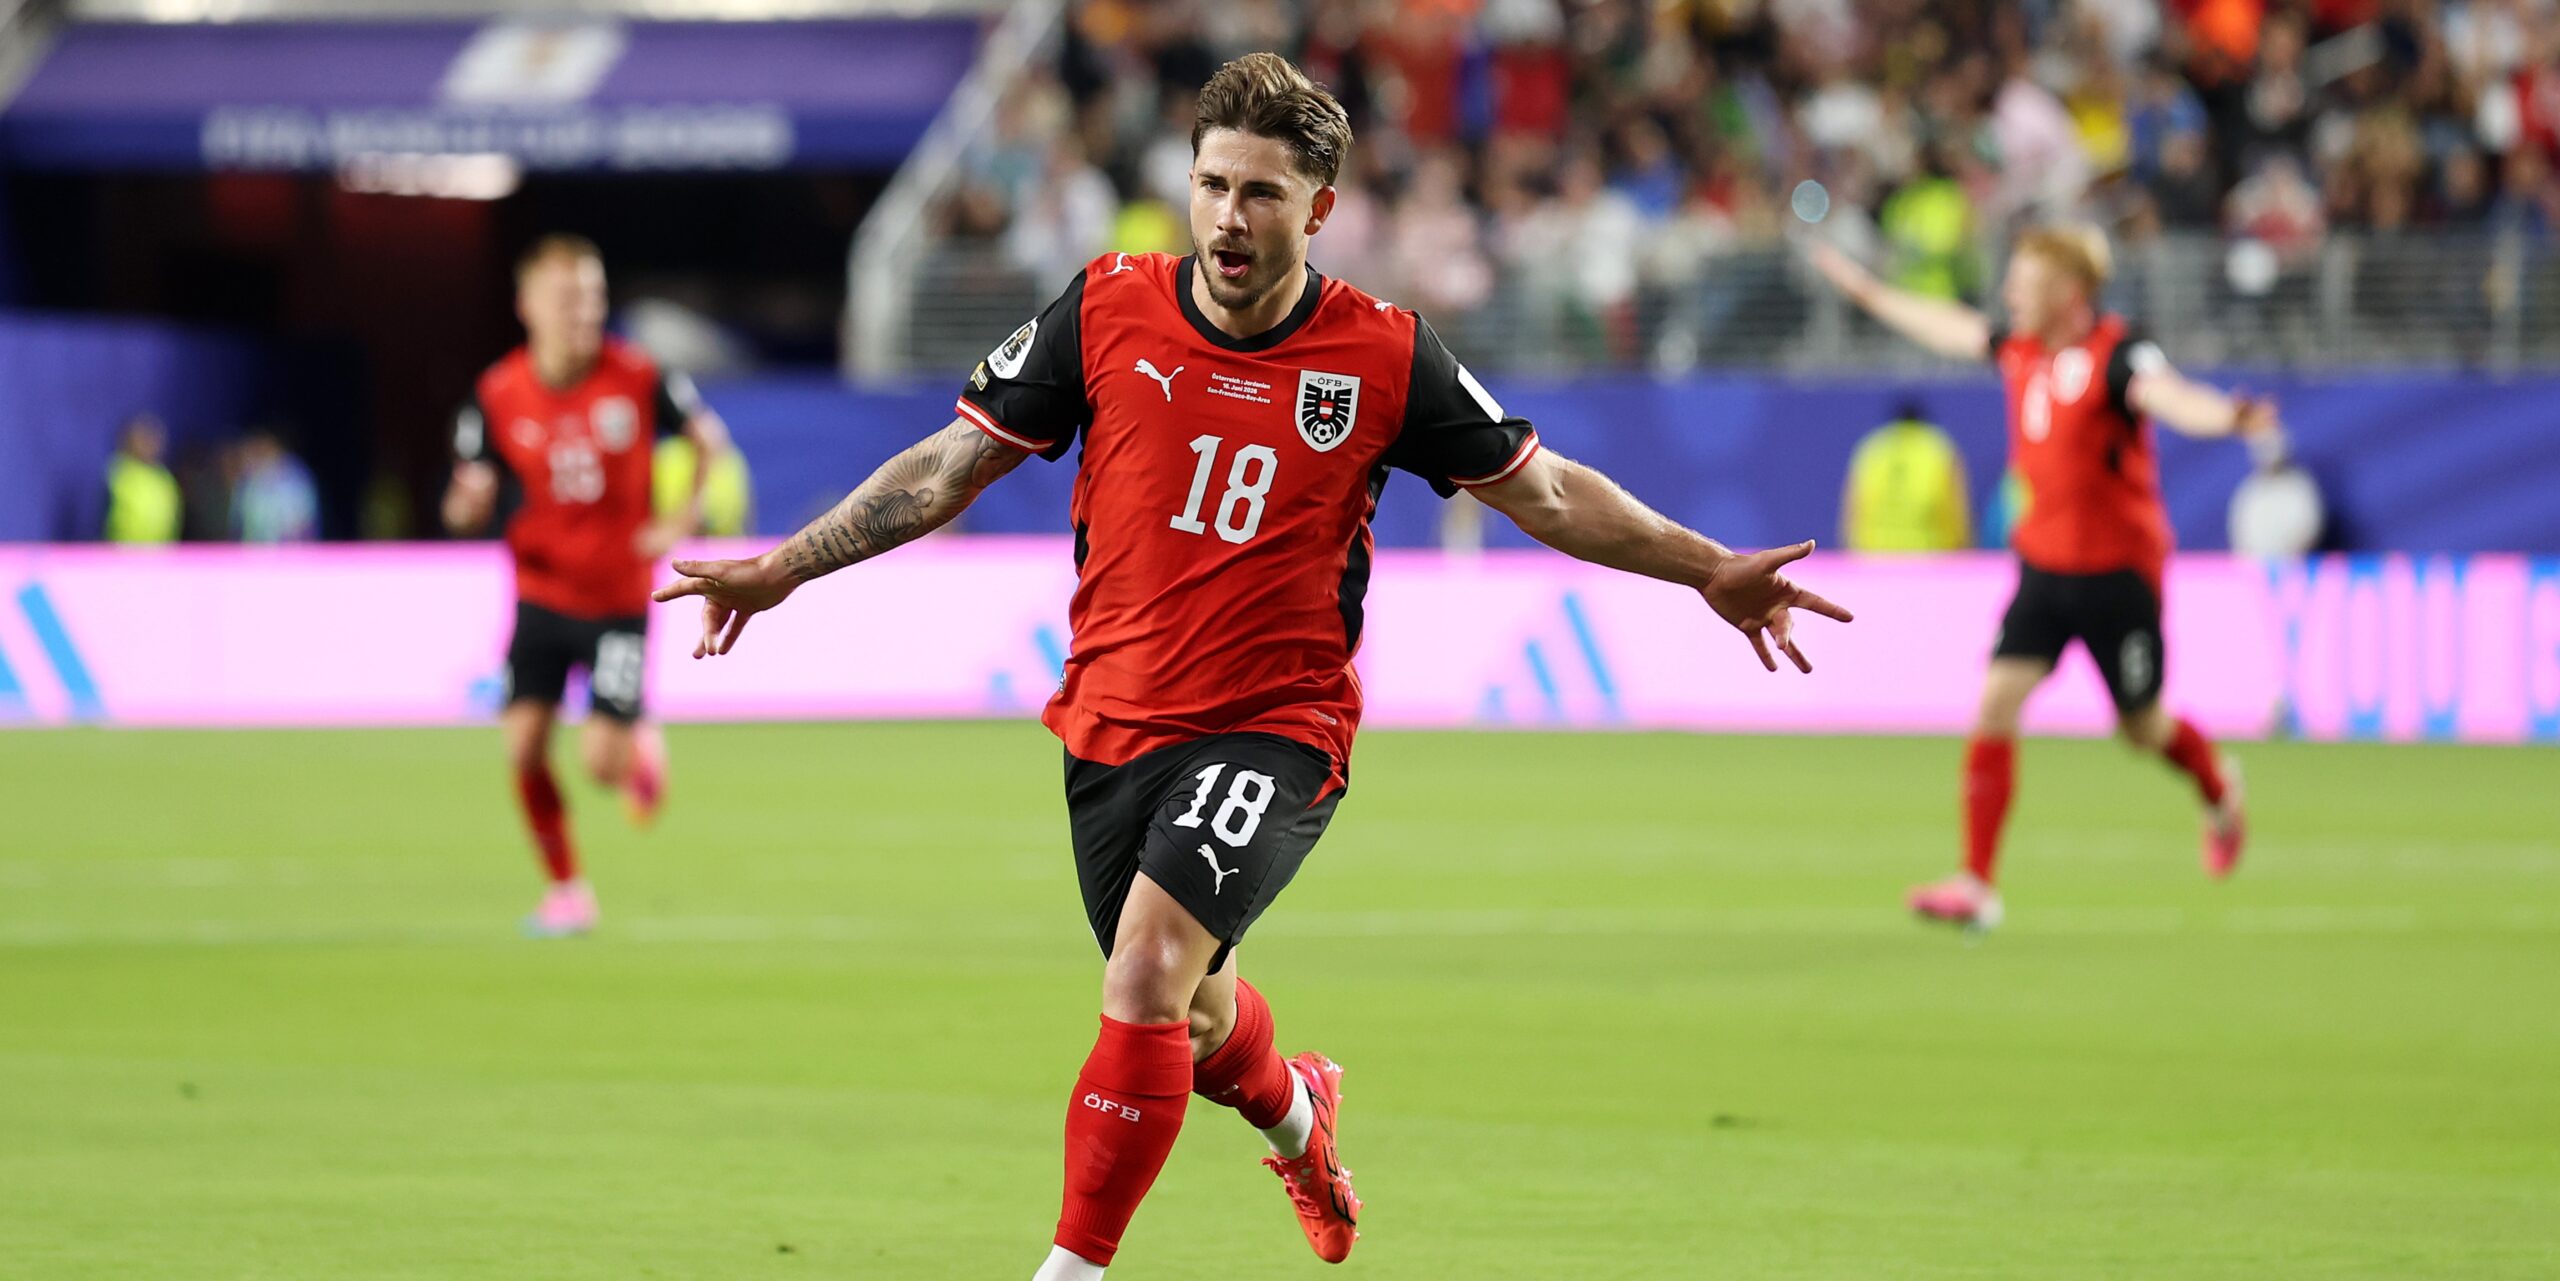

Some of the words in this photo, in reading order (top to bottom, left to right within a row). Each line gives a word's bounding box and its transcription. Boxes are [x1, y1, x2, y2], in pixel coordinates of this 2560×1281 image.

[1244, 380, 1271, 390] Jordanien
[1317, 376, 1342, 387] ÖFB
[1169, 434, 1279, 544] 18
[1172, 763, 1276, 847] 18
[1084, 1093, 1140, 1122] ÖFB
